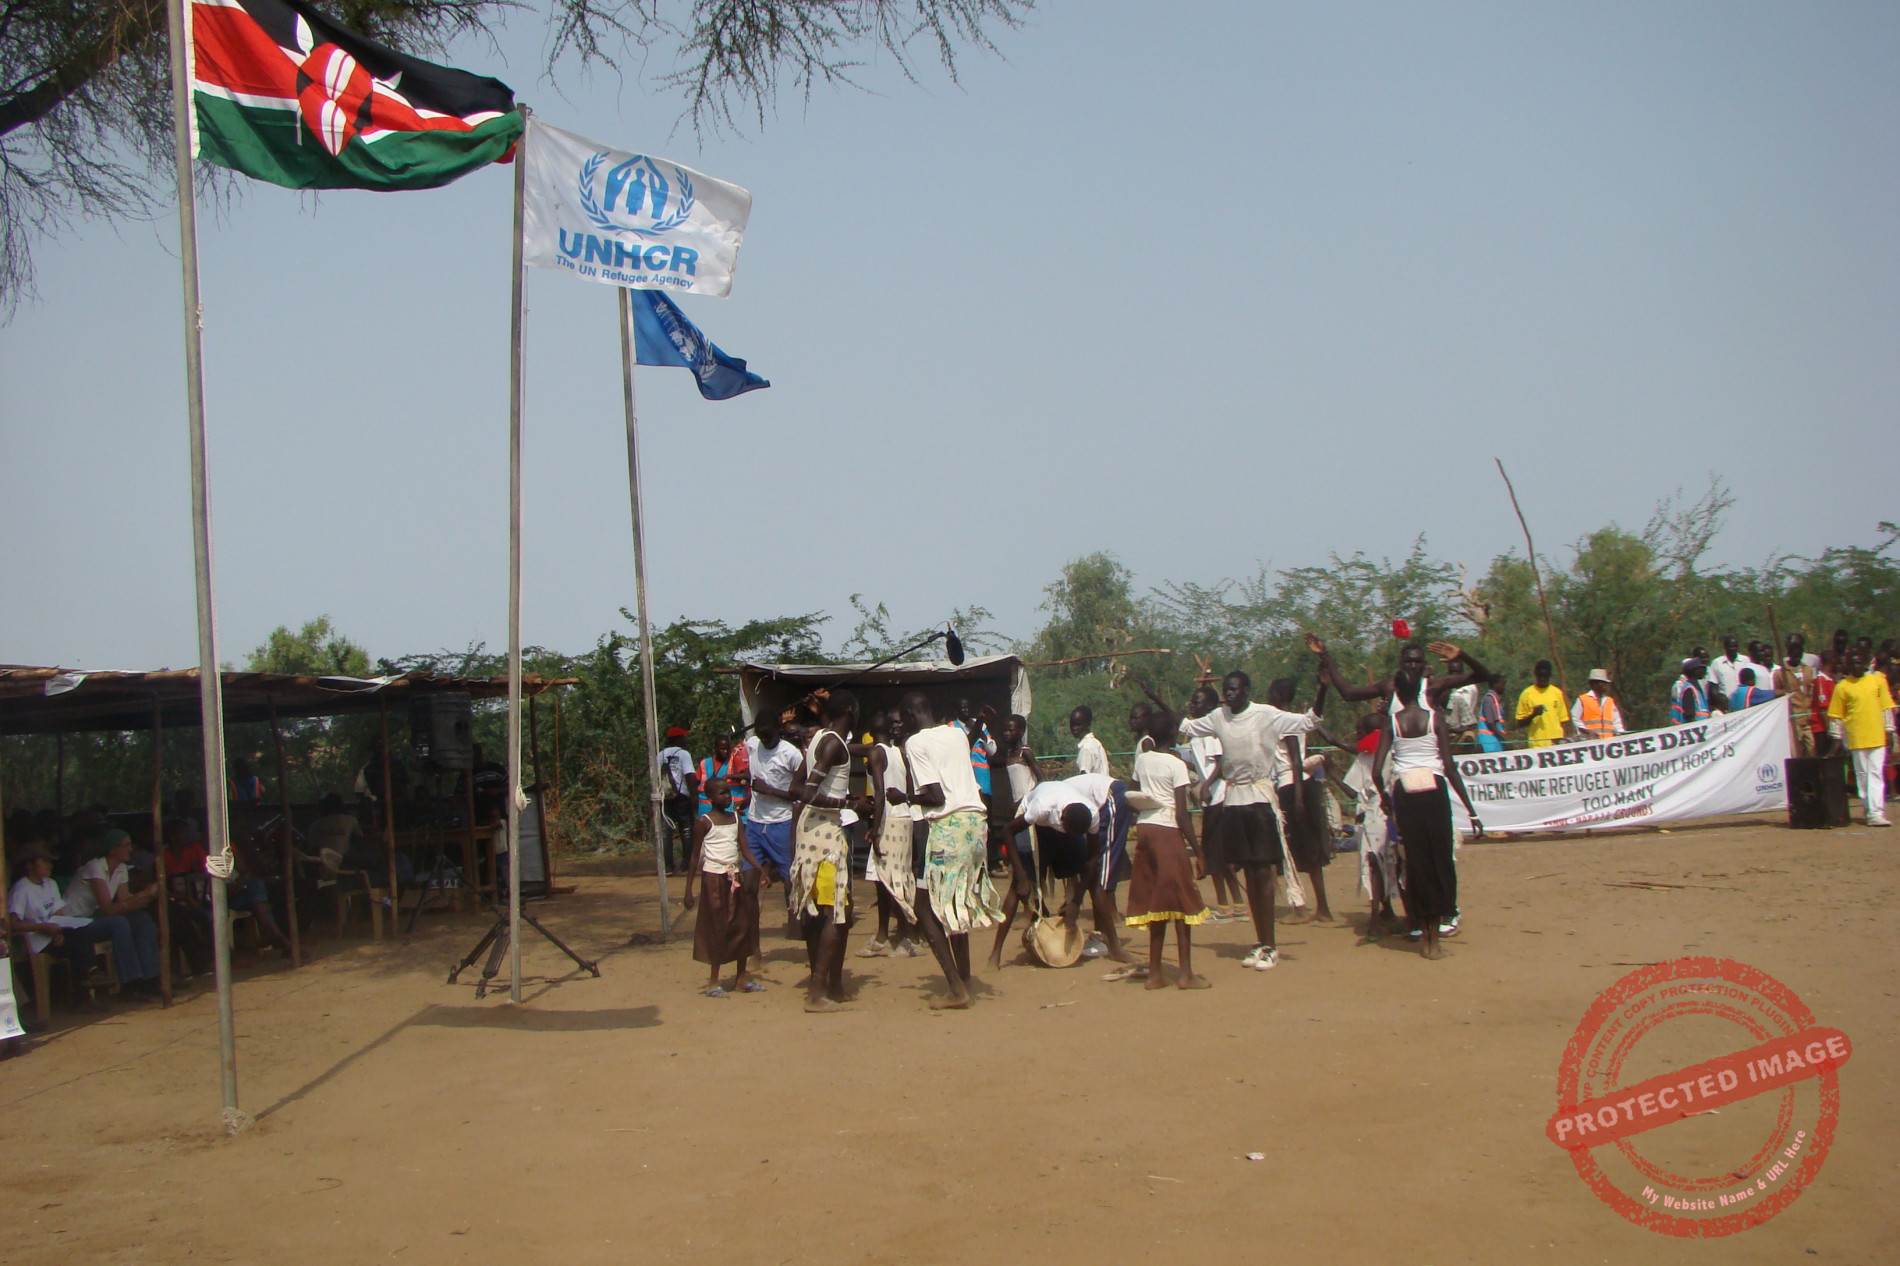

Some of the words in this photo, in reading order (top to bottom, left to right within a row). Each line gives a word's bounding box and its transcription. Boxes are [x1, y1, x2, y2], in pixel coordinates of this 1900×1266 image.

[555, 255, 575, 270] The
[578, 265, 597, 277] UN
[601, 269, 648, 285] Refugee
[651, 273, 694, 289] Agency
[559, 227, 699, 276] UNHCR
[1455, 754, 1534, 777] ORLD
[1537, 736, 1656, 769] REFUGEE
[1658, 725, 1708, 750] DAY
[1549, 770, 1611, 796] REFUGEE
[1613, 759, 1678, 787] WITHOUT
[1681, 747, 1717, 771] HOPE
[1722, 742, 1735, 758] IS
[1581, 795, 1612, 812] TOO
[1614, 784, 1655, 806] MANY
[1755, 782, 1783, 793] UNHCR
